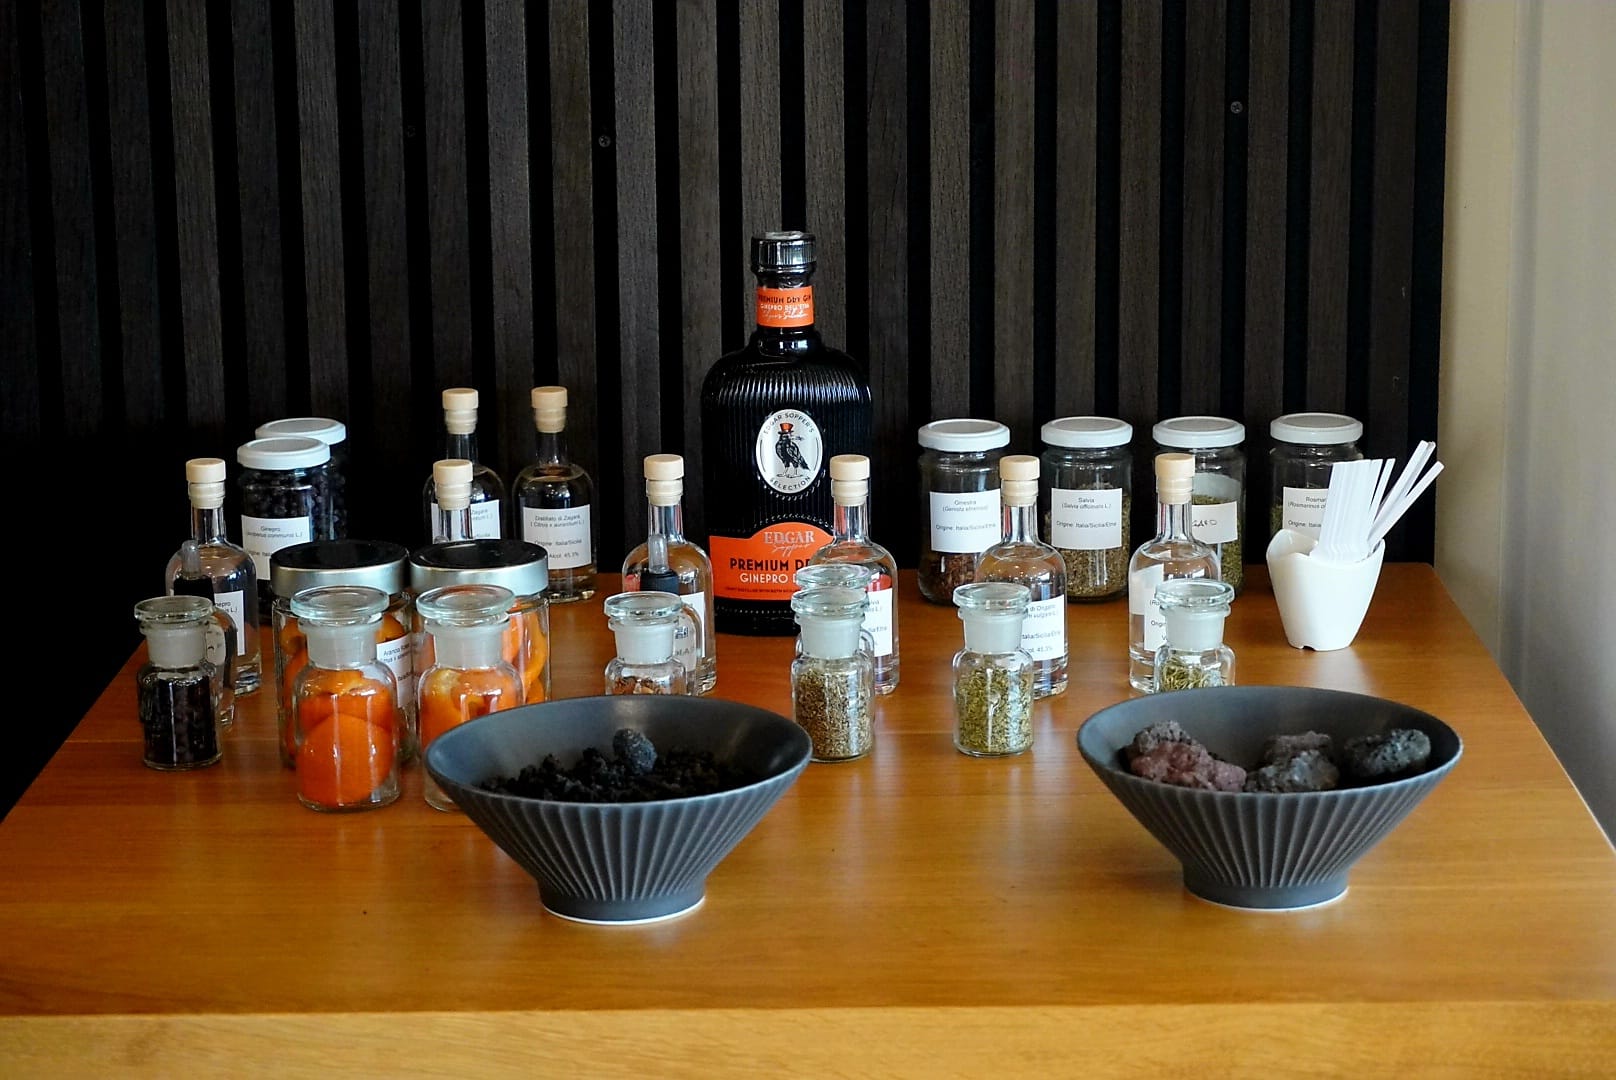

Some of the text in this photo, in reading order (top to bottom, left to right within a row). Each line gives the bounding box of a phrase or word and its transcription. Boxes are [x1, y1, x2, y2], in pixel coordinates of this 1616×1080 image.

[763, 414, 783, 435] EDGAR
[769, 476, 811, 491] SELECTION
[763, 530, 815, 544] EDGAR
[729, 557, 789, 572] PREMIUM
[739, 572, 789, 584] GINEPRO
